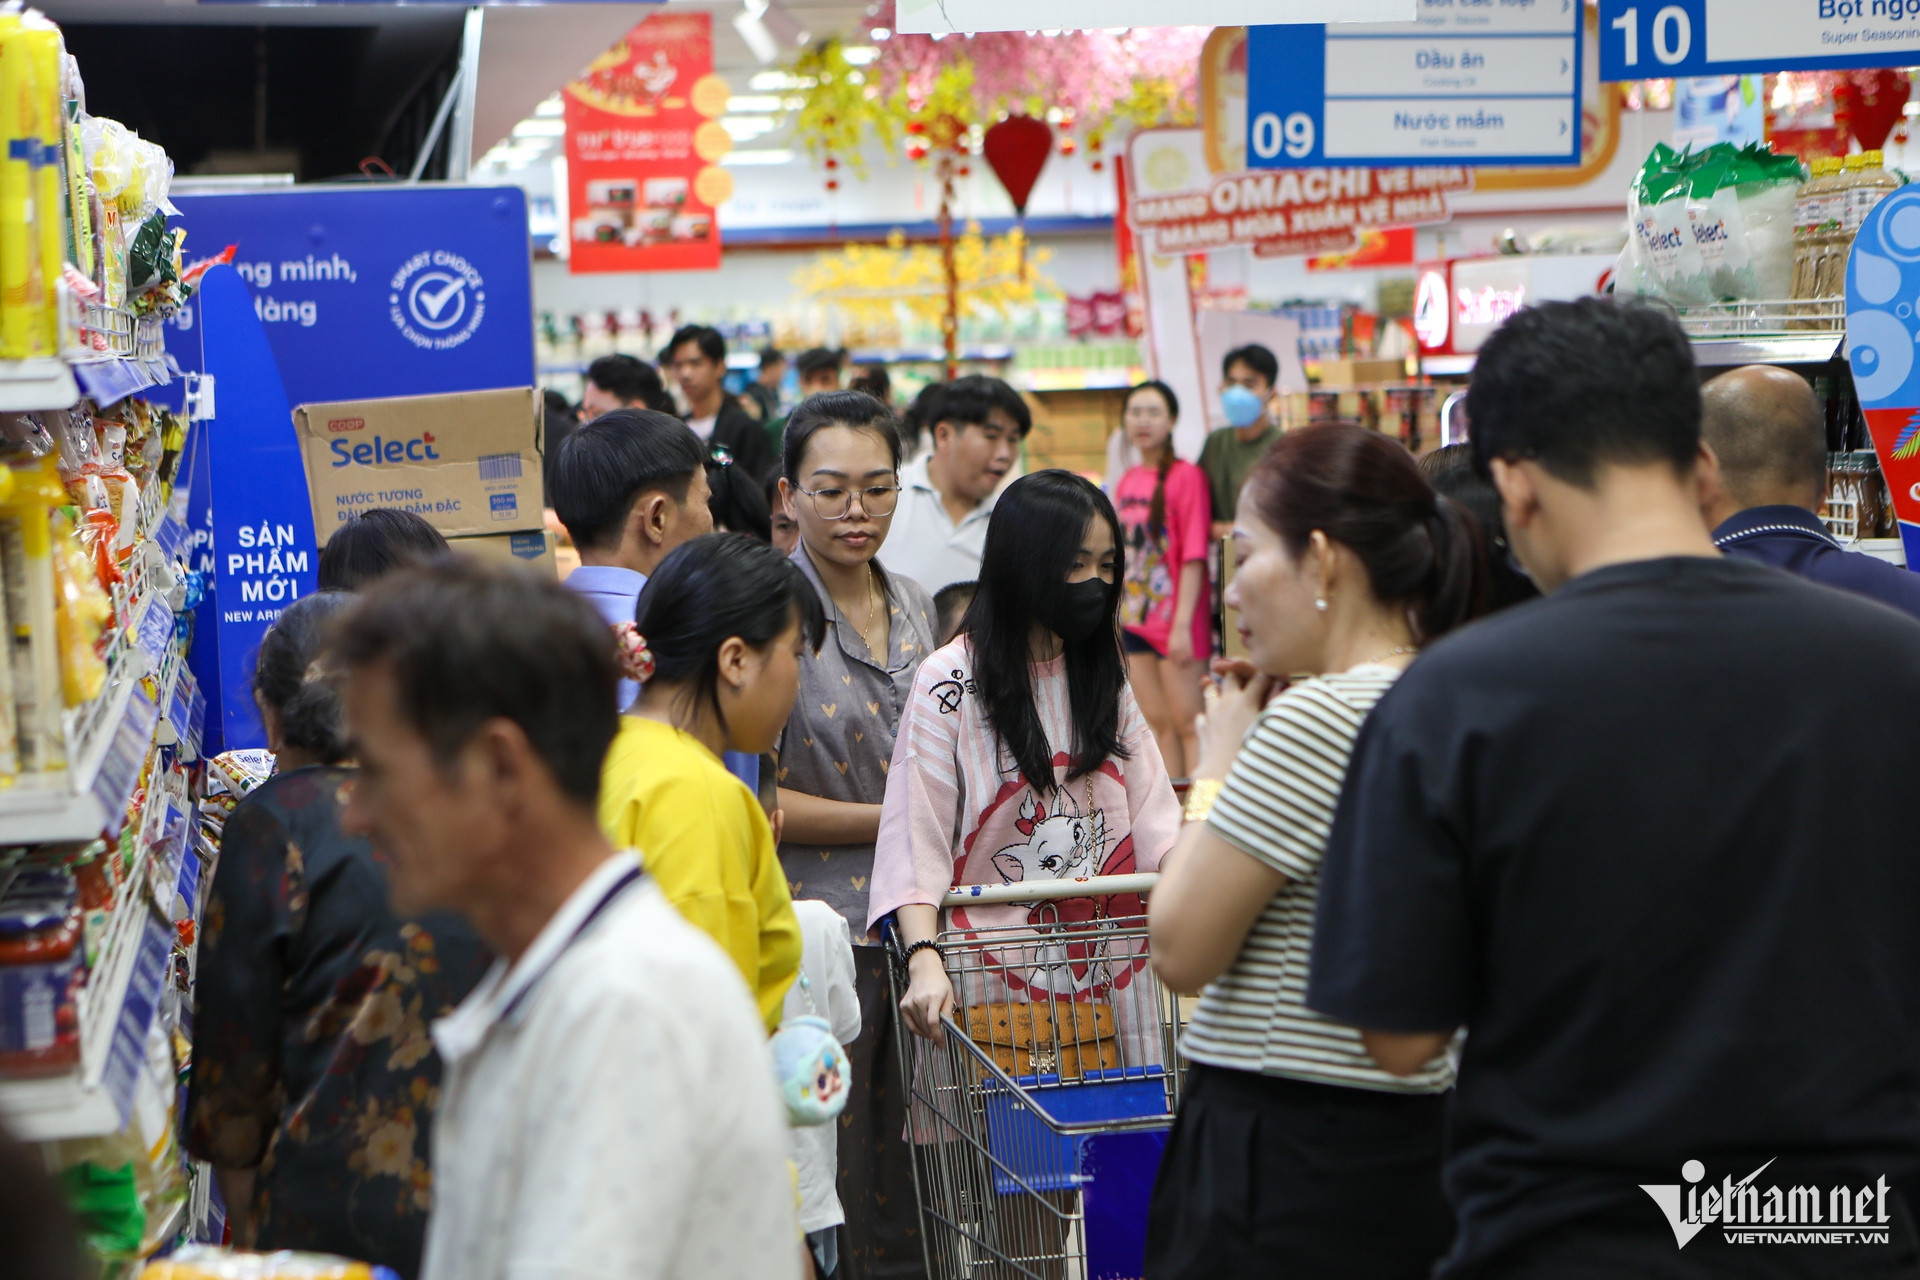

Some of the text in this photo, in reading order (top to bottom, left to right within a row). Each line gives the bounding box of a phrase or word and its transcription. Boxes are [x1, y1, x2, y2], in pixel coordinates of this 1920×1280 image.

[1611, 6, 1692, 66] 10
[1821, 27, 1920, 45] Super Seasonin
[1415, 47, 1455, 69] Dầu
[1394, 110, 1450, 130] Nước
[1252, 112, 1316, 159] 09
[1211, 169, 1371, 214] OMACHI
[280, 252, 357, 284] minh,
[390, 250, 431, 291] SMART
[432, 249, 484, 291] CHOICE
[328, 419, 365, 432] COOP
[330, 431, 440, 468] Select
[336, 488, 424, 506] NƯỚC TƯƠNG
[238, 519, 295, 548] SẢN
[228, 546, 309, 576] PHẨM
[241, 574, 298, 603] MỚI
[224, 611, 253, 623] NEW
[236, 753, 273, 765] Selet
